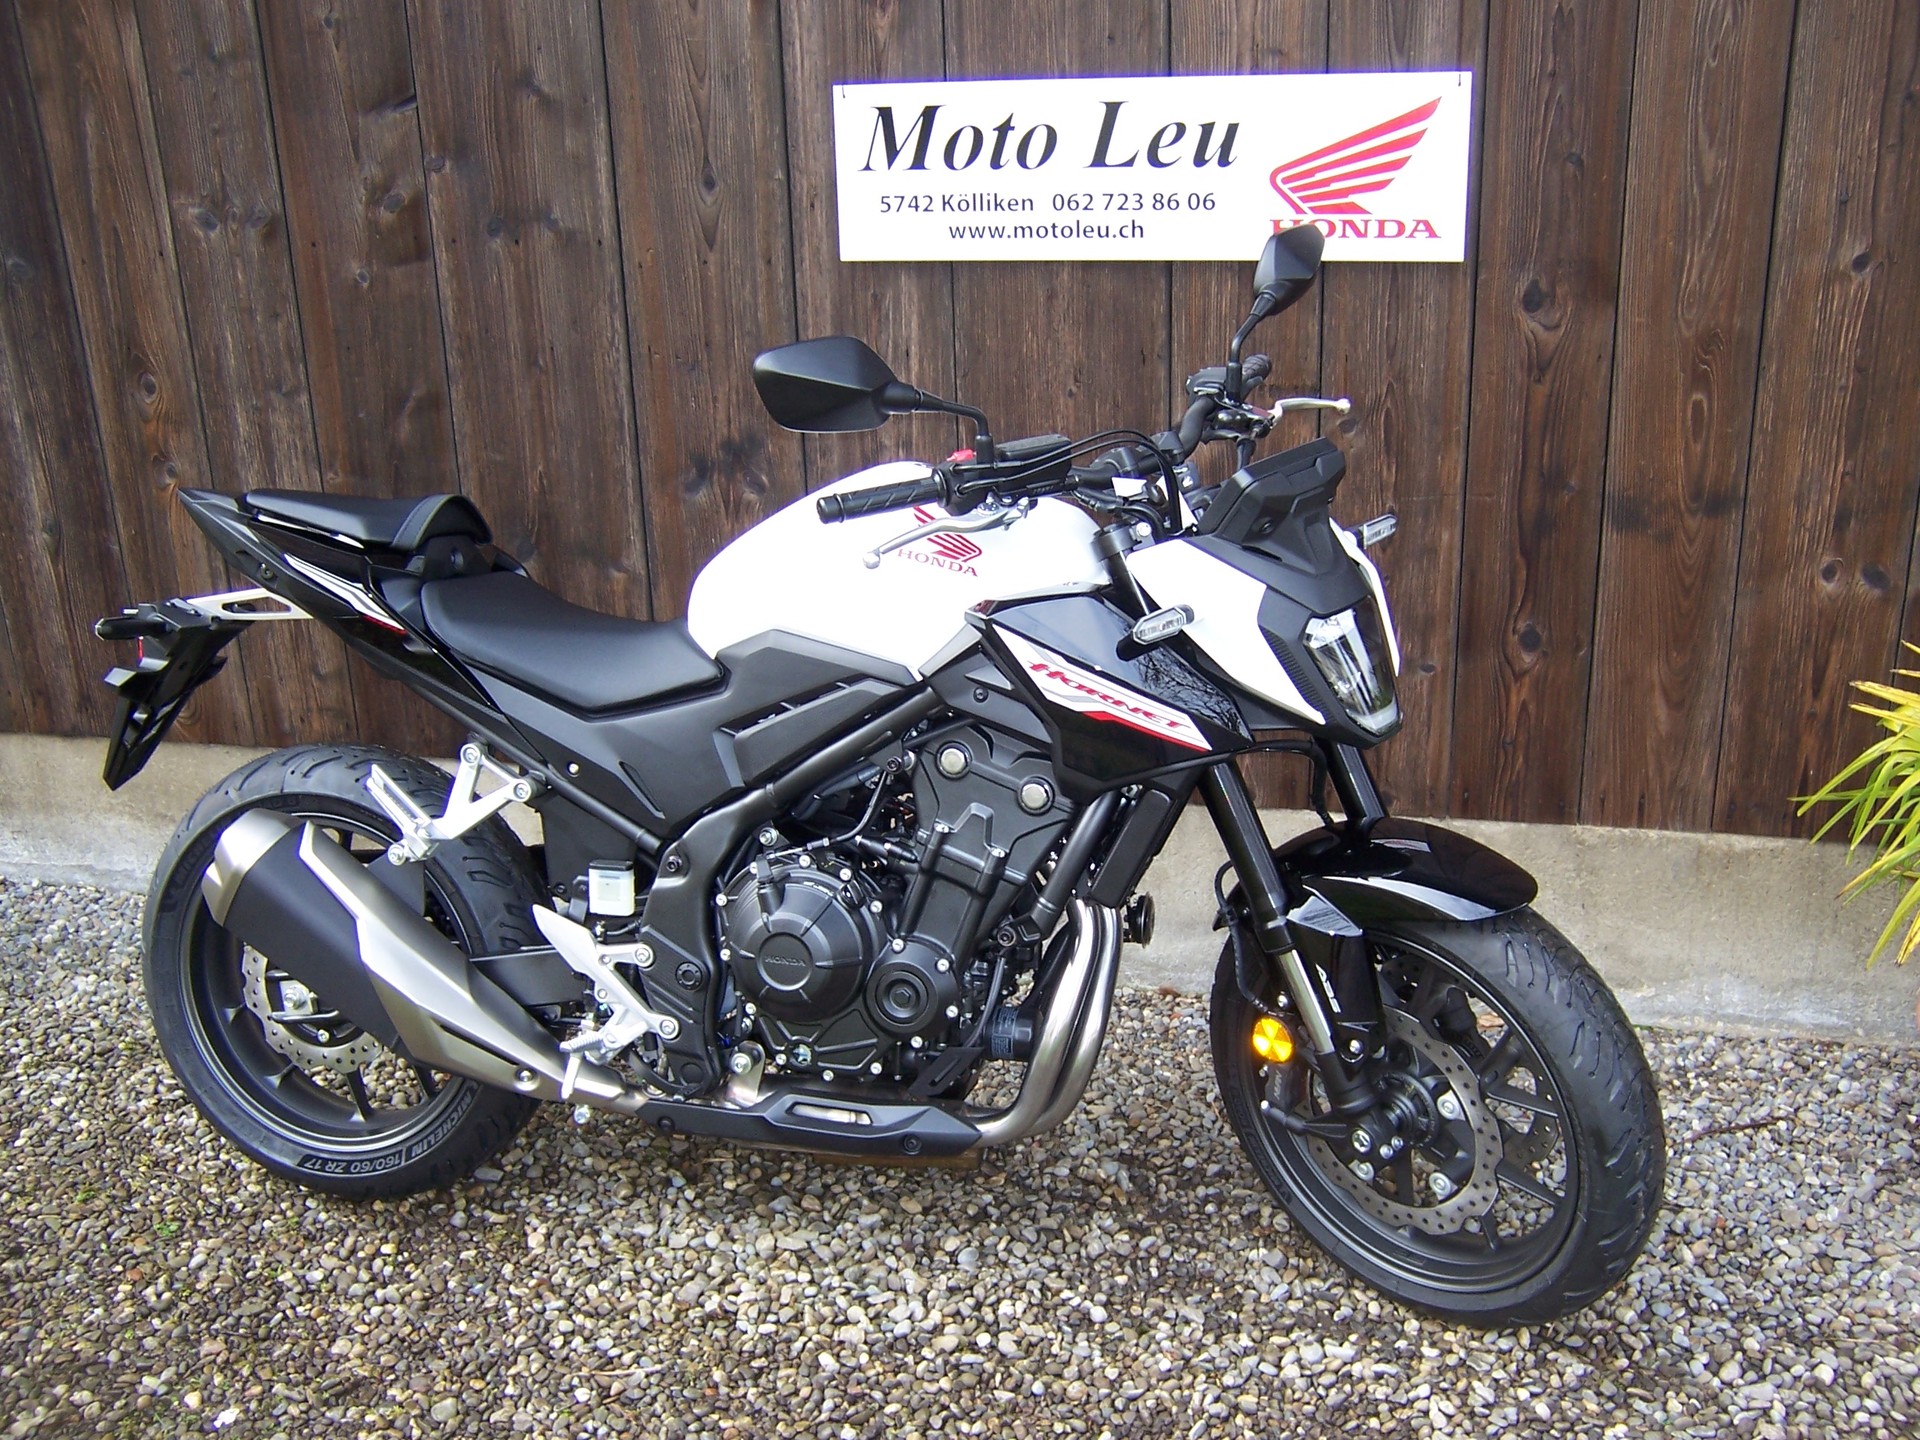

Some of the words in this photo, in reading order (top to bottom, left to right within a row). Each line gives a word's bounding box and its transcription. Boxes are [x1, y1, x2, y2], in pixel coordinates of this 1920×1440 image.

[859, 104, 1058, 172] Moto
[1085, 101, 1240, 168] Leu
[880, 195, 934, 213] 5742
[942, 192, 1034, 212] Kölliken
[1052, 193, 1094, 212] 062
[1102, 193, 1144, 212] 723
[1152, 193, 1180, 211] 86
[1187, 192, 1216, 211] 06
[948, 219, 1145, 239] www.motoleu.ch
[897, 548, 979, 577] HONDA
[764, 954, 806, 967] HONDA
[411, 1089, 473, 1158] MICHELIN
[304, 1157, 323, 1171] 17
[325, 1159, 347, 1173] ZR
[350, 1152, 401, 1173] 160/60
